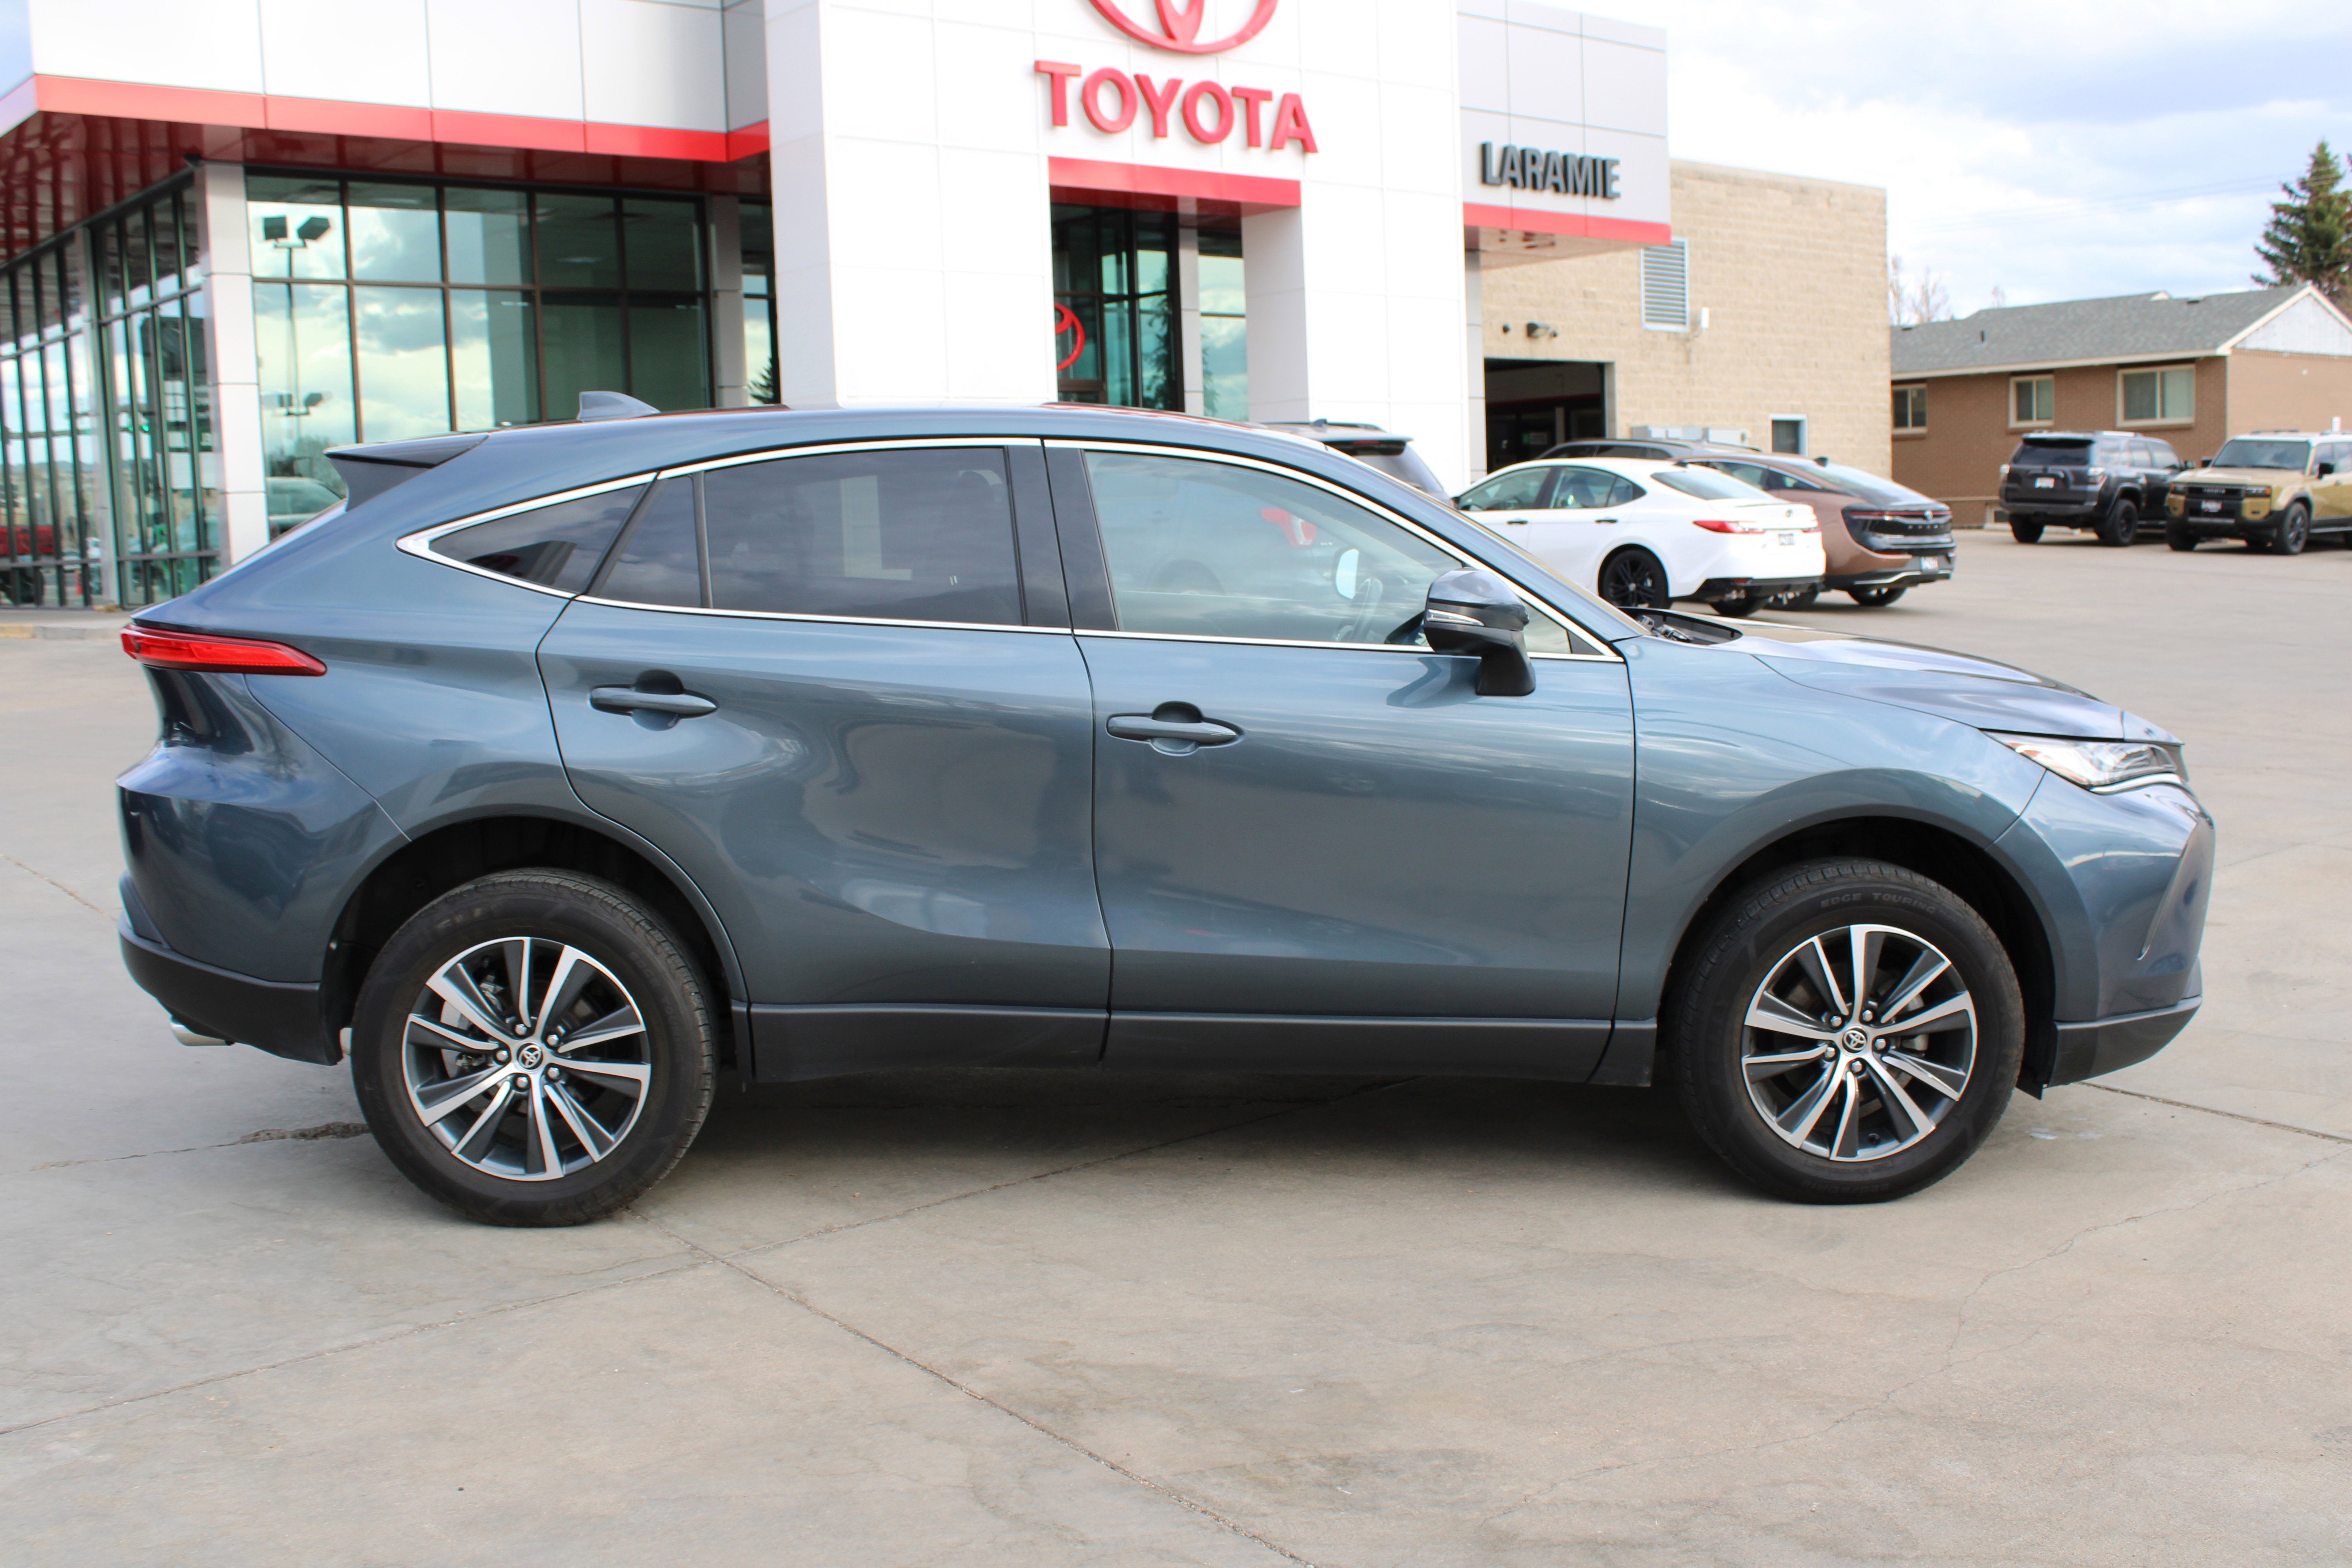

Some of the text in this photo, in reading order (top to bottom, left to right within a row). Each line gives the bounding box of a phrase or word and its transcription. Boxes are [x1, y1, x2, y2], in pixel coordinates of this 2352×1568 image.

[1034, 60, 1319, 154] TOYOTA
[1481, 142, 1621, 199] LARAMIE
[1821, 893, 1936, 914] EDGE TOURING
